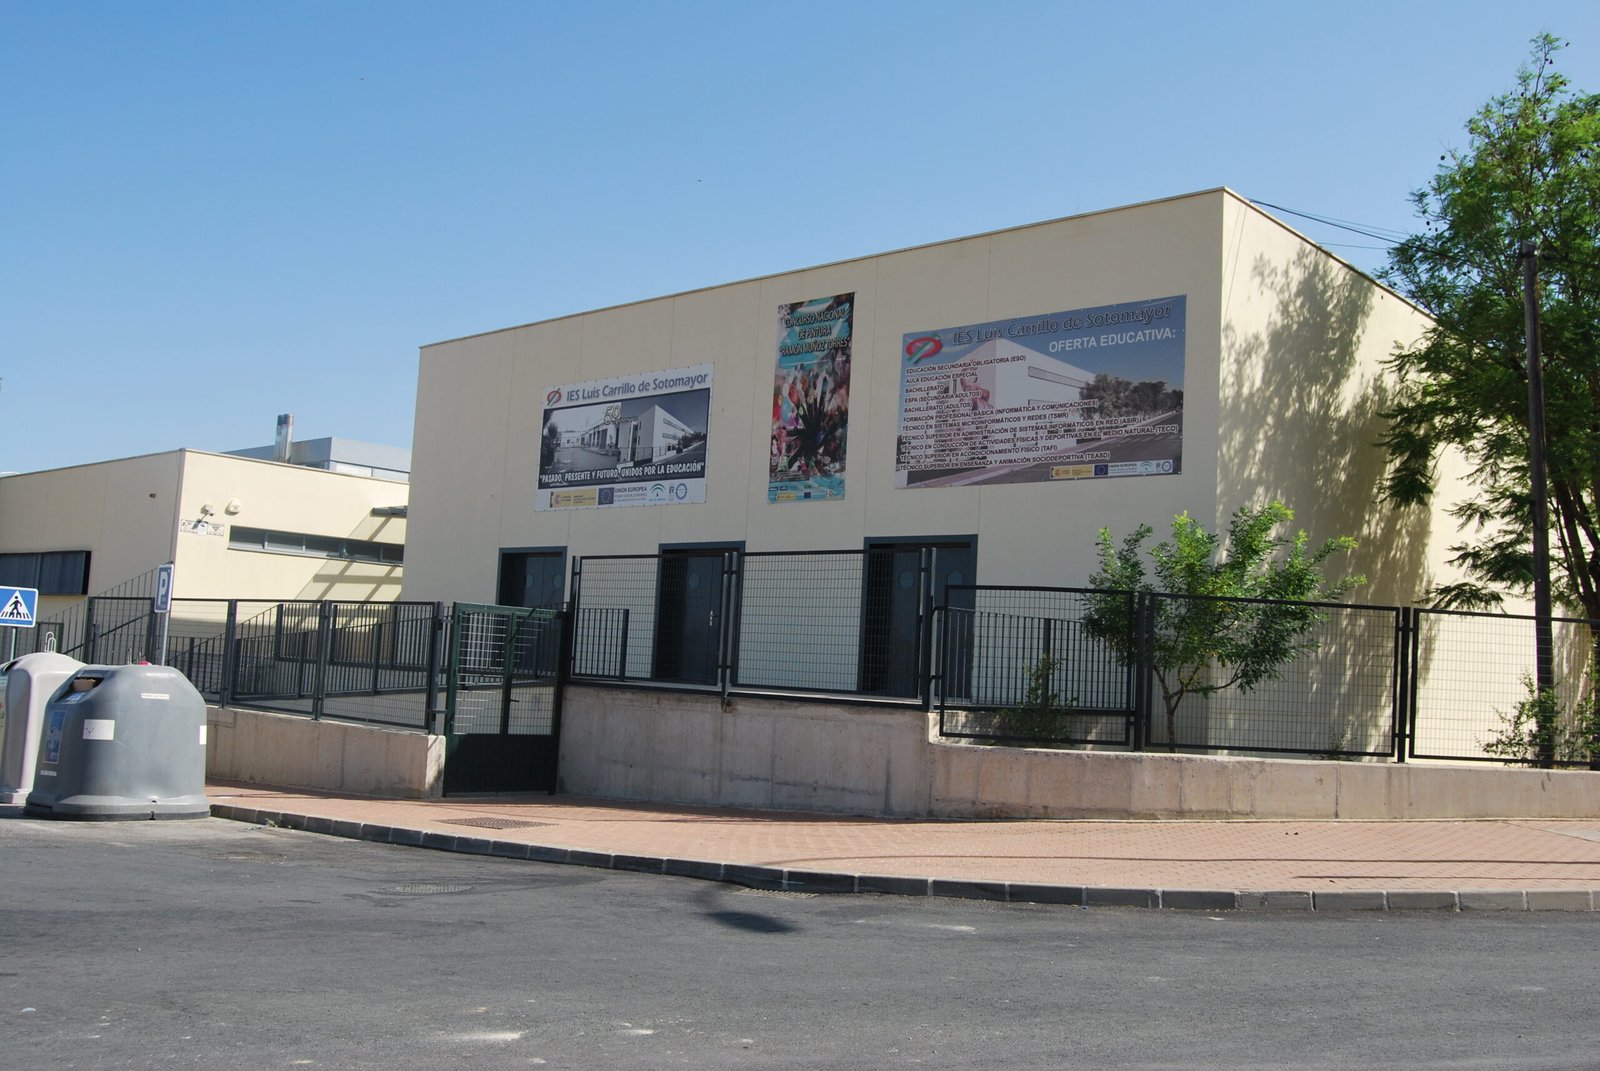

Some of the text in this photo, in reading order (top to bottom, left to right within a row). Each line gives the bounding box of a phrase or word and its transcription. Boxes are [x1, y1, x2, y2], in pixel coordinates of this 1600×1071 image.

[807, 326, 831, 338] PINTURA
[953, 330, 972, 345] IES
[1007, 320, 1058, 337] Carrillo
[1063, 316, 1082, 330] de
[1086, 305, 1172, 328] Sotomayor
[1049, 328, 1176, 352] OFERTA EDUCATIVA:
[906, 355, 1026, 374] EDUCACIÓN SECUNDARIA OBLIGATORIA (ESO)
[921, 373, 951, 382] EDUCACIÓN
[567, 373, 708, 401] IES Luis Carrillo de Sotomayor
[905, 385, 944, 393] BACHILLERATO
[919, 394, 954, 402] (SECUNDARIA
[904, 402, 972, 413] BACHILLERATO (ADULTOS)
[995, 406, 1035, 416] (INFORMÁTICA
[1042, 400, 1098, 410] COMUNICACIONES)
[962, 416, 1020, 426] MICROINFORMÁTICOS
[1048, 412, 1068, 420] (TSMR)
[962, 427, 1008, 436] ADMINISTRACIÓN
[1049, 421, 1094, 429] INFORMÁTICOS
[933, 441, 968, 449] CONDUCCIÓN
[978, 437, 1017, 445] ACTIVIDADES
[1045, 432, 1082, 440] DEPORTIVAS
[1156, 425, 1178, 433] (TECO)
[960, 448, 1019, 456] ACONDICIONAMIENTO
[960, 459, 993, 467] ENSEÑANZA
[1032, 454, 1084, 463] SOCIODEPORTIVA
[540, 460, 704, 484] "PASADO, PRESENTE Y FUTURO, UNIDOS POR LA EDUCACIÓN"
[159, 571, 168, 605] P
